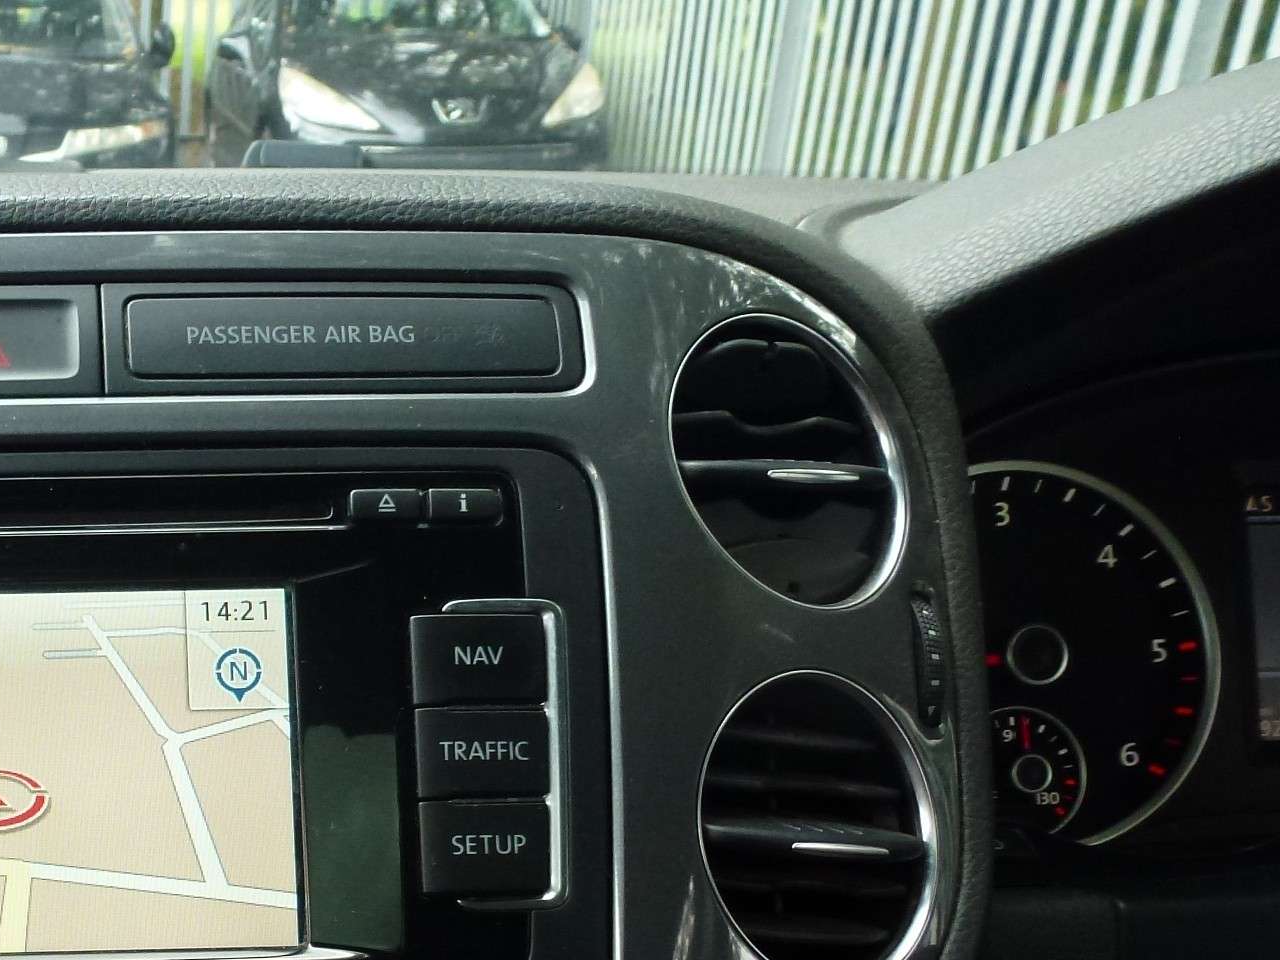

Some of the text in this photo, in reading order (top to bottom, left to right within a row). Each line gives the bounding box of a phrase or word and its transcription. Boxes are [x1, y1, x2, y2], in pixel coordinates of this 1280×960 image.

[185, 325, 316, 345] PASSENGER
[324, 325, 362, 344] AIR
[368, 325, 415, 343] BAG
[994, 501, 1010, 527] 3
[1096, 544, 1118, 568] 4
[201, 600, 271, 622] 14:21
[453, 645, 504, 665] NAV
[1151, 638, 1168, 663] 5
[230, 661, 248, 682] N
[439, 740, 530, 762] TRAFFIC
[1120, 742, 1140, 767] 6
[1036, 791, 1060, 805] 130
[451, 834, 527, 856] SETUP
